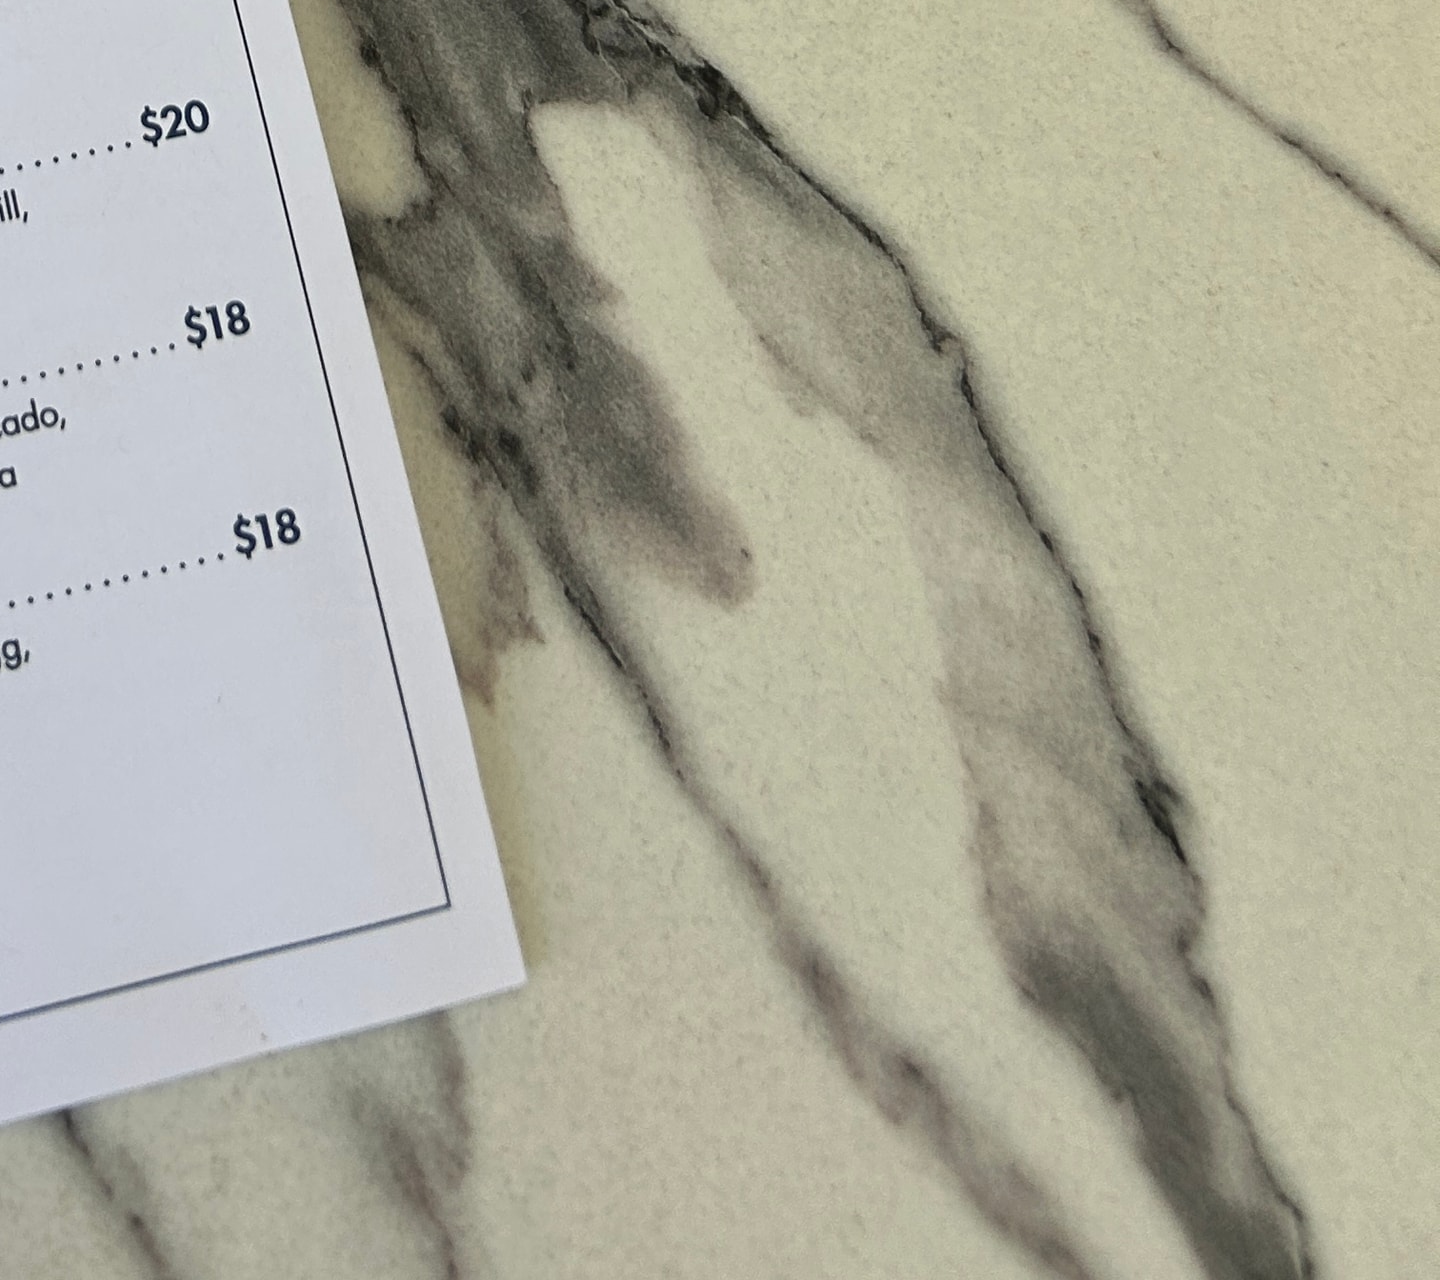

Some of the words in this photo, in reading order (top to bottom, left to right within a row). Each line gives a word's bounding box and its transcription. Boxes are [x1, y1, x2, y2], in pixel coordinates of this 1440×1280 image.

[140, 99, 210, 148] $20
[184, 300, 251, 351] $18
[233, 507, 301, 561] $18
